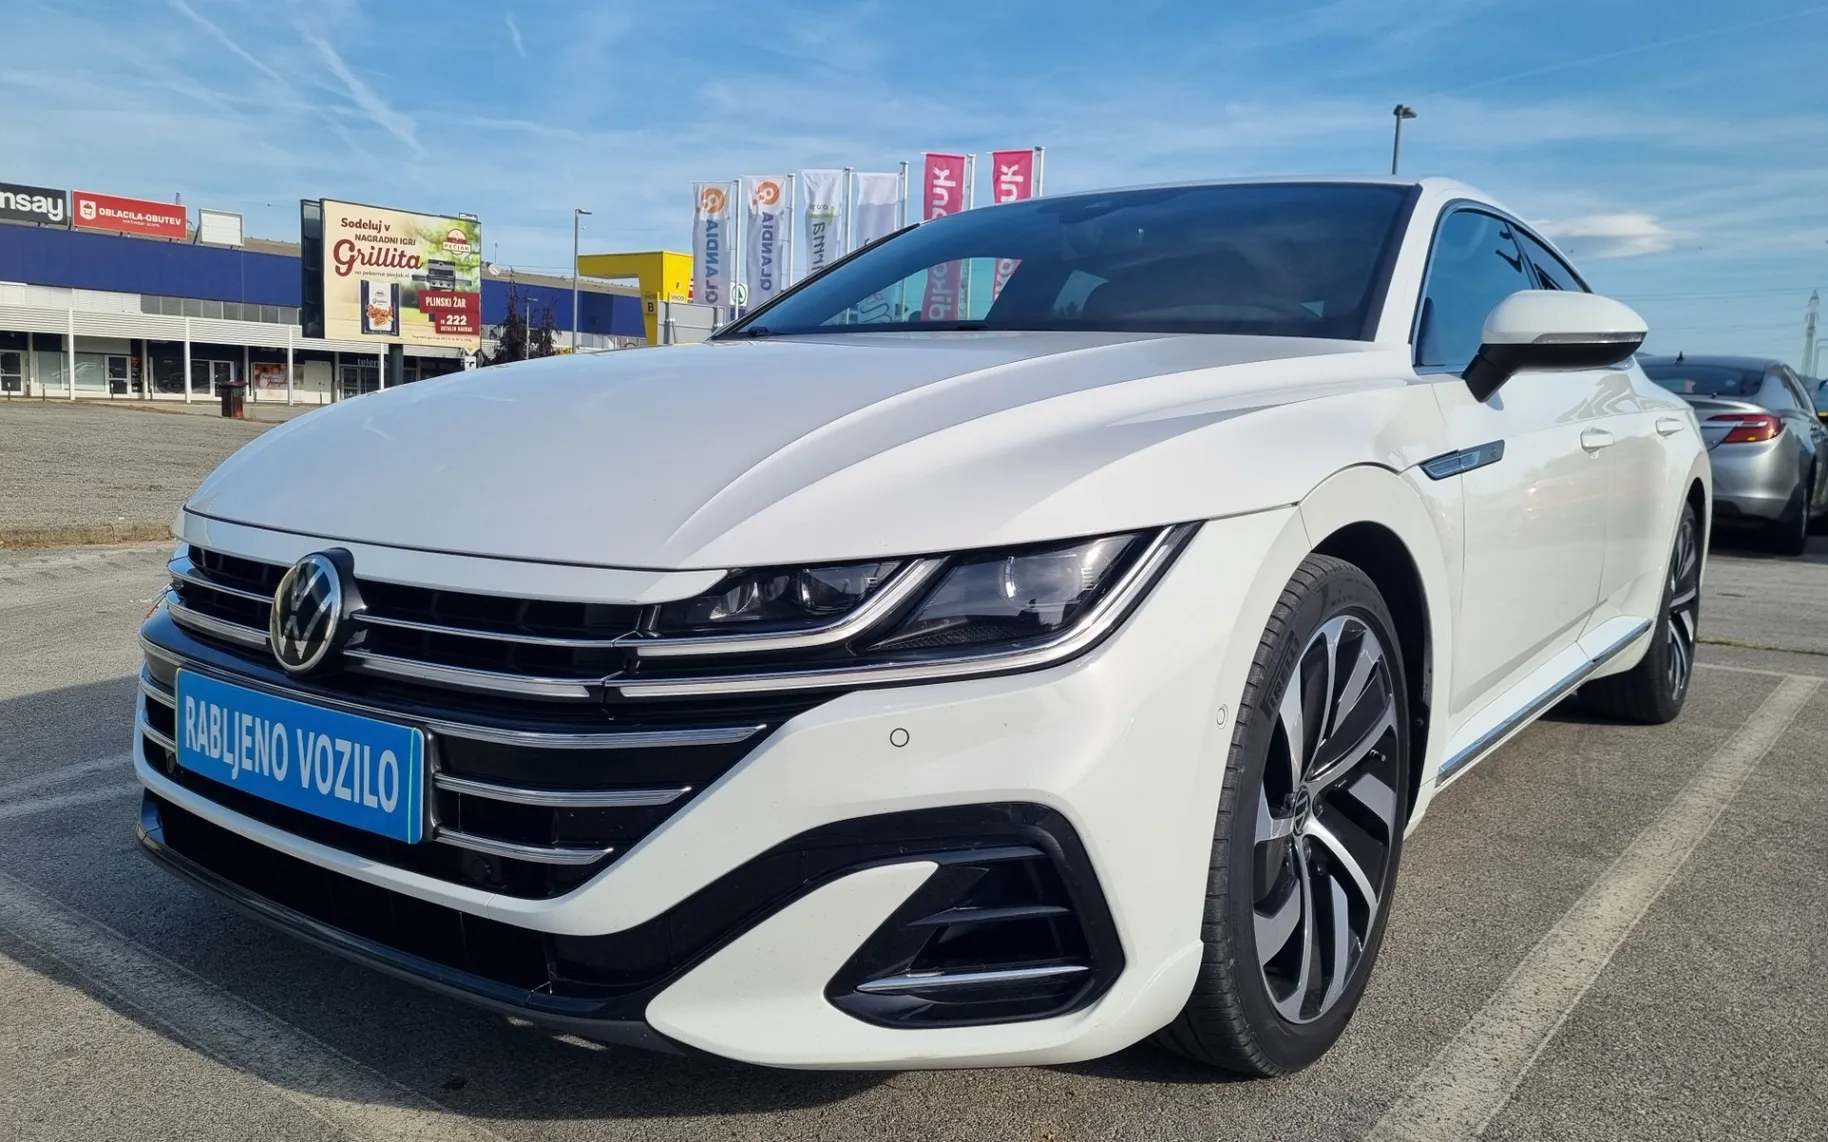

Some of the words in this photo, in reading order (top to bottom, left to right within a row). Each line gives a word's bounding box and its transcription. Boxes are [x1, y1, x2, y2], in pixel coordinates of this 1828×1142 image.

[0, 191, 63, 221] nsay
[341, 217, 382, 233] Sodeluj
[384, 223, 391, 232] v
[354, 233, 399, 245] NAGRADNI
[399, 237, 416, 247] IGRI
[333, 238, 424, 277] Grillita
[425, 296, 452, 308] PLINSKI
[453, 296, 467, 309] ŽAR
[446, 314, 467, 326] 222
[185, 695, 289, 782] RABLJENO
[296, 728, 399, 814] VOZILO
